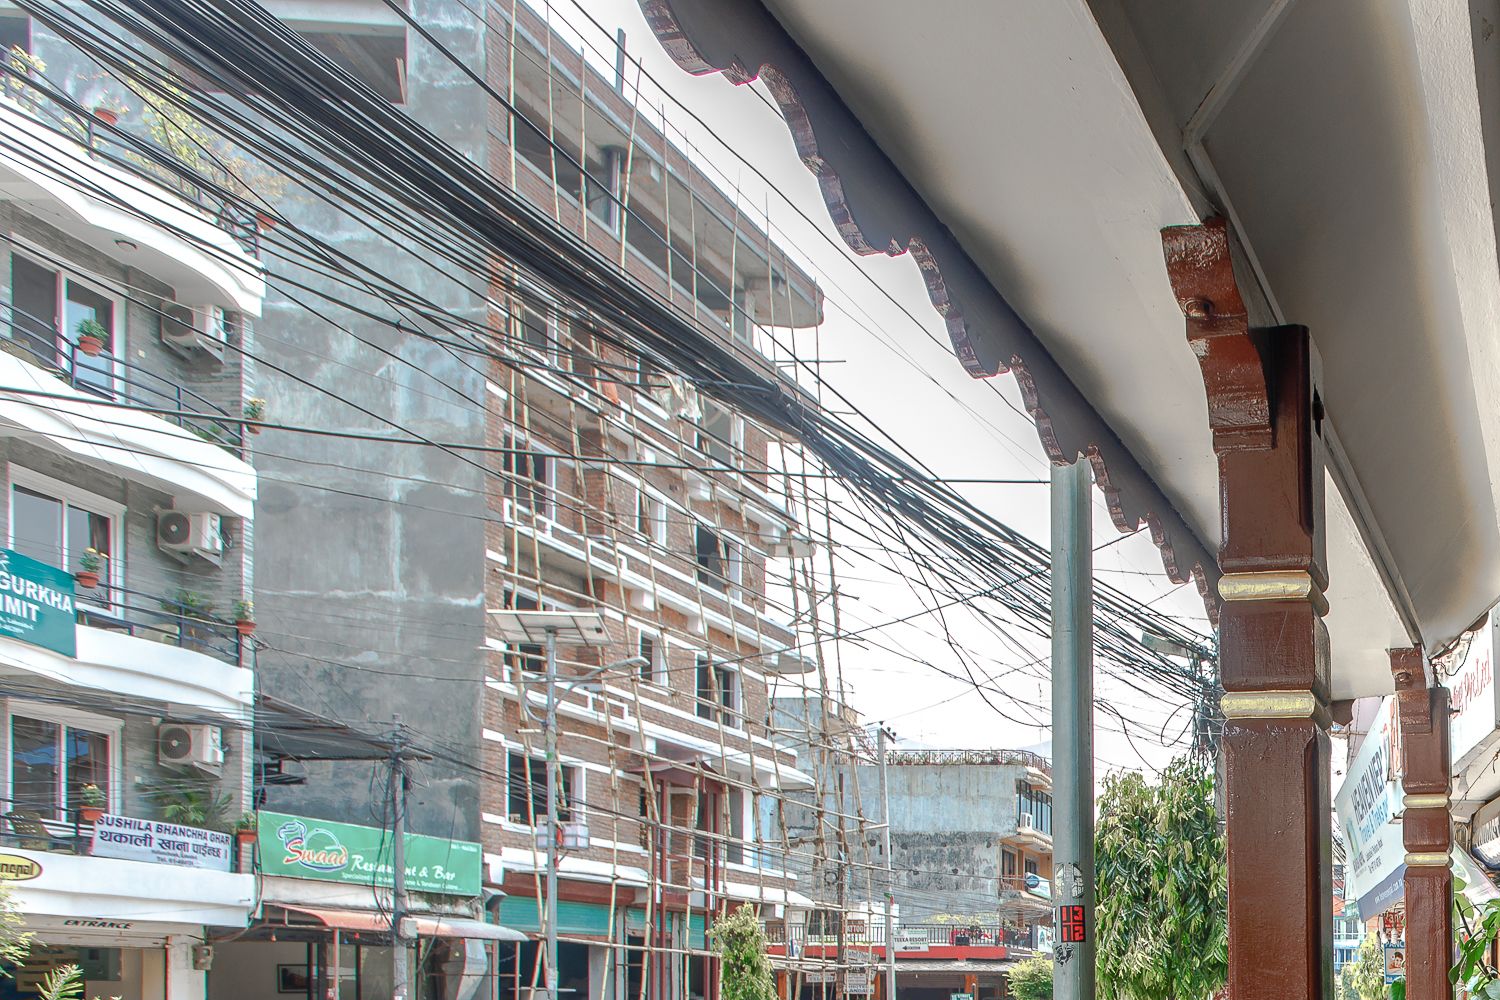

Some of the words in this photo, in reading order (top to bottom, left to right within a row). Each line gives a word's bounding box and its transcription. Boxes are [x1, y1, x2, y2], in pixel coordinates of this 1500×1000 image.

[0, 571, 74, 614] GURKHA
[96, 815, 153, 833] SUSHILA
[155, 823, 208, 842] BHANCHHA
[209, 832, 231, 845] GHAR
[158, 837, 190, 853] खाना
[283, 839, 349, 865] Swaad
[351, 854, 417, 877] Restaurnt
[419, 866, 429, 878] &
[432, 865, 456, 881] Bar
[1061, 905, 1083, 921] 13
[64, 919, 134, 929] ENTRANCE
[1062, 926, 1085, 941] 12
